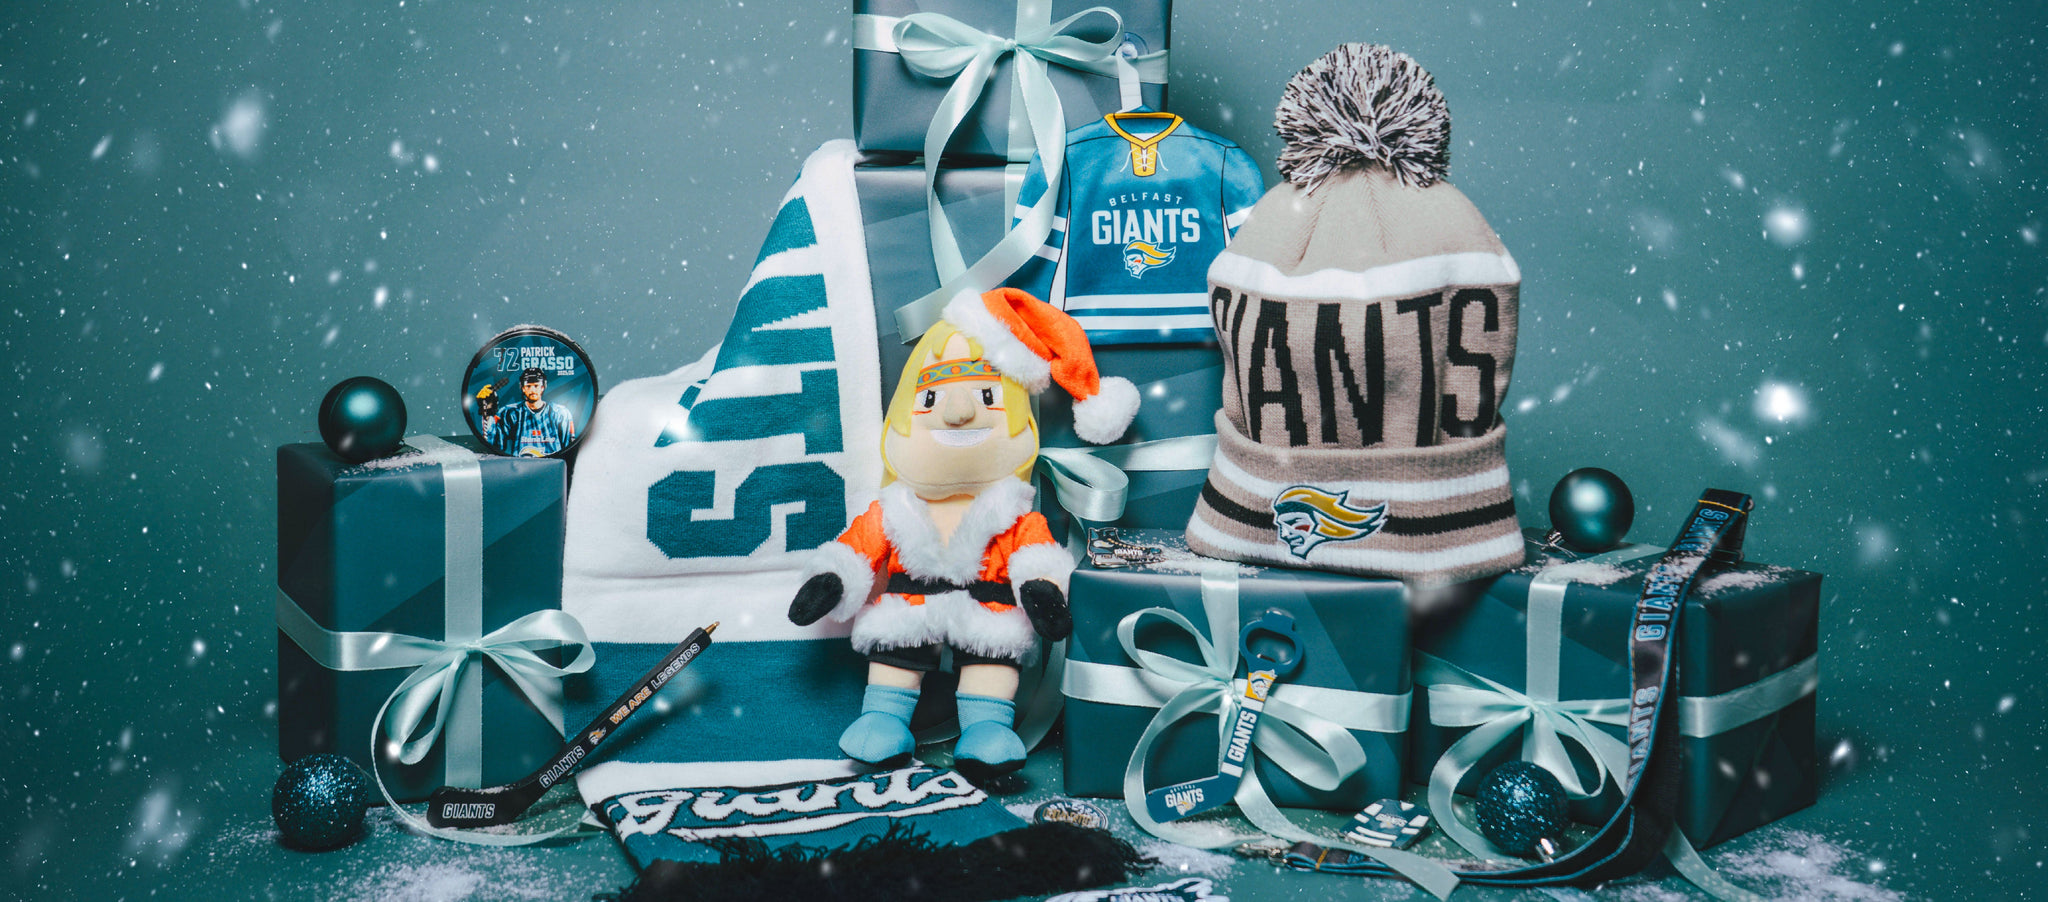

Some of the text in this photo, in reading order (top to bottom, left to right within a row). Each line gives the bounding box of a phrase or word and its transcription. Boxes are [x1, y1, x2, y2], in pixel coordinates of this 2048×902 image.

[1109, 192, 1183, 207] BELFAST
[1091, 207, 1201, 245] GIANTS
[493, 347, 520, 372] 72
[520, 346, 555, 357] PATRICK
[521, 356, 574, 371] GRASSO
[610, 642, 701, 725] WE ARE LEGENDS
[1227, 710, 1258, 763] GIANTS
[539, 745, 586, 789] GIANTS
[1165, 788, 1204, 808] GIANTS
[442, 803, 496, 819] GIANTS
